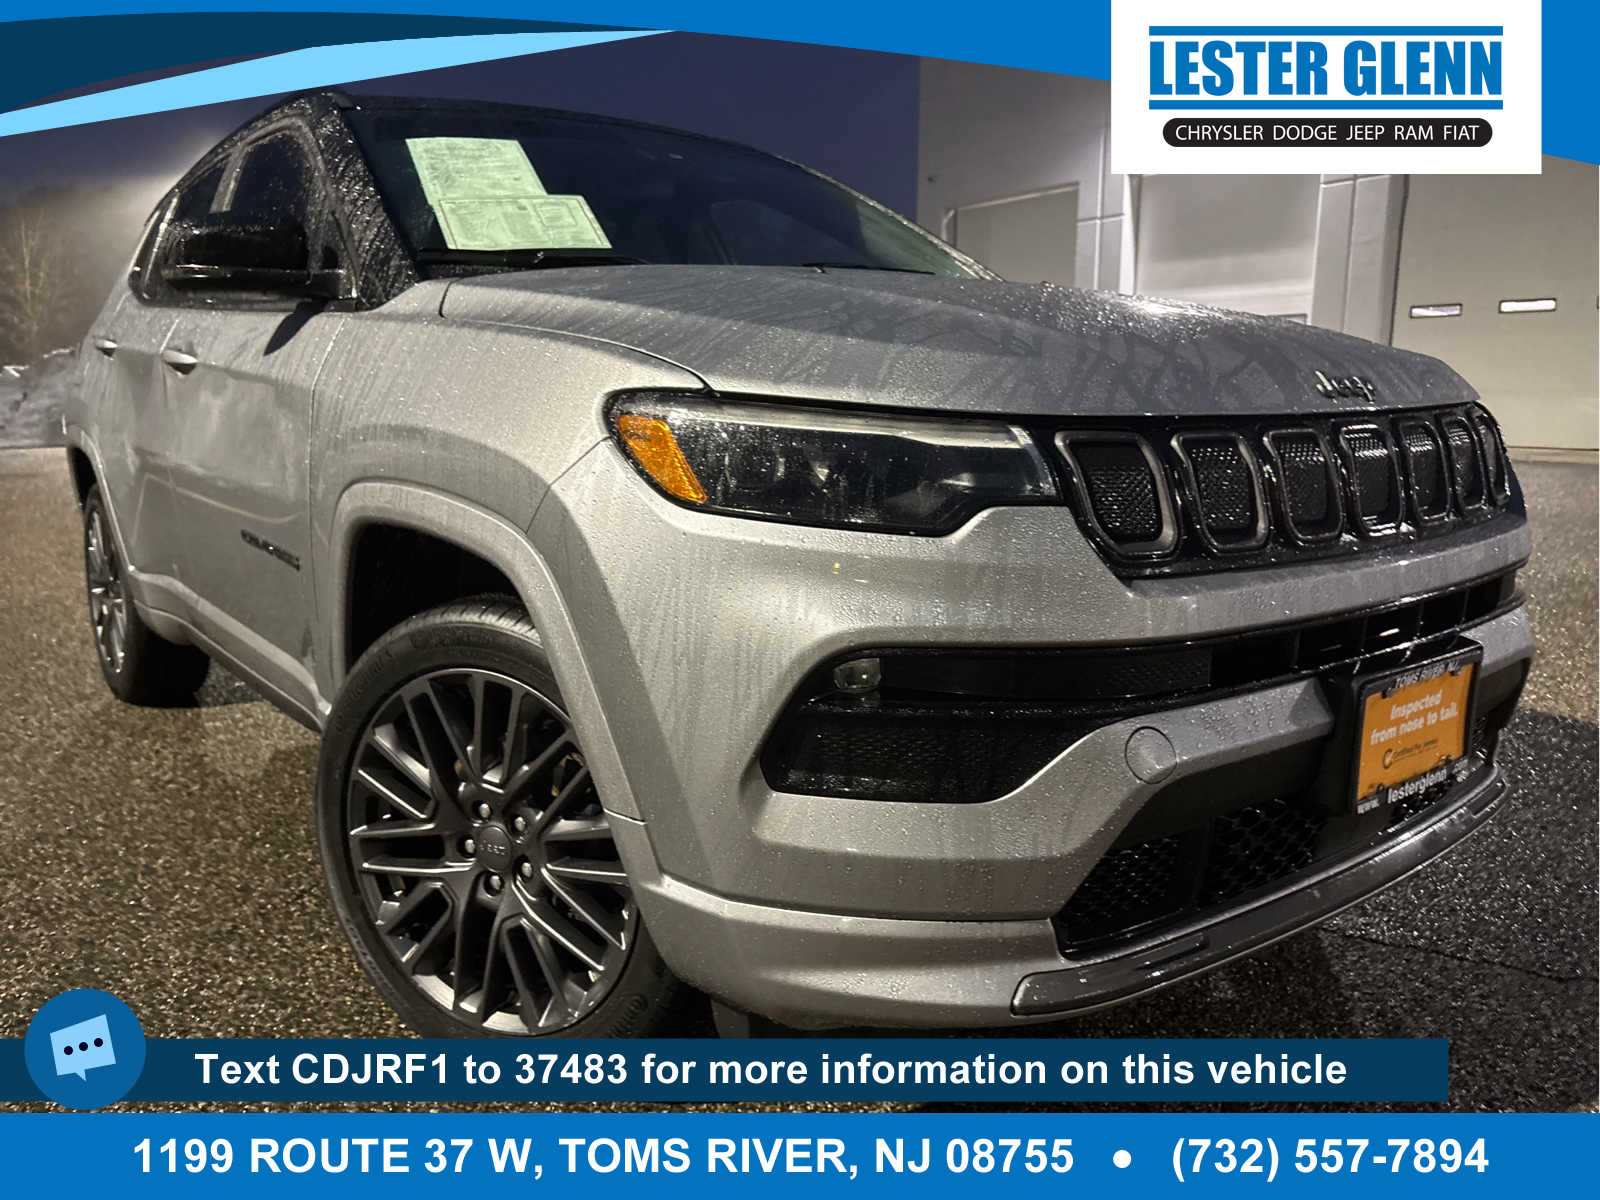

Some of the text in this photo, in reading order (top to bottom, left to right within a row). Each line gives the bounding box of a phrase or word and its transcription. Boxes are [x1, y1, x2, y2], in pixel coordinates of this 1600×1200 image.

[1314, 369, 1377, 404] Jeep
[1396, 672, 1419, 688] TOMS
[1390, 690, 1443, 720] Inspected
[1370, 726, 1397, 745] from
[1399, 719, 1425, 735] nose
[1426, 712, 1438, 725] to
[1387, 768, 1448, 804] lesterglenn
